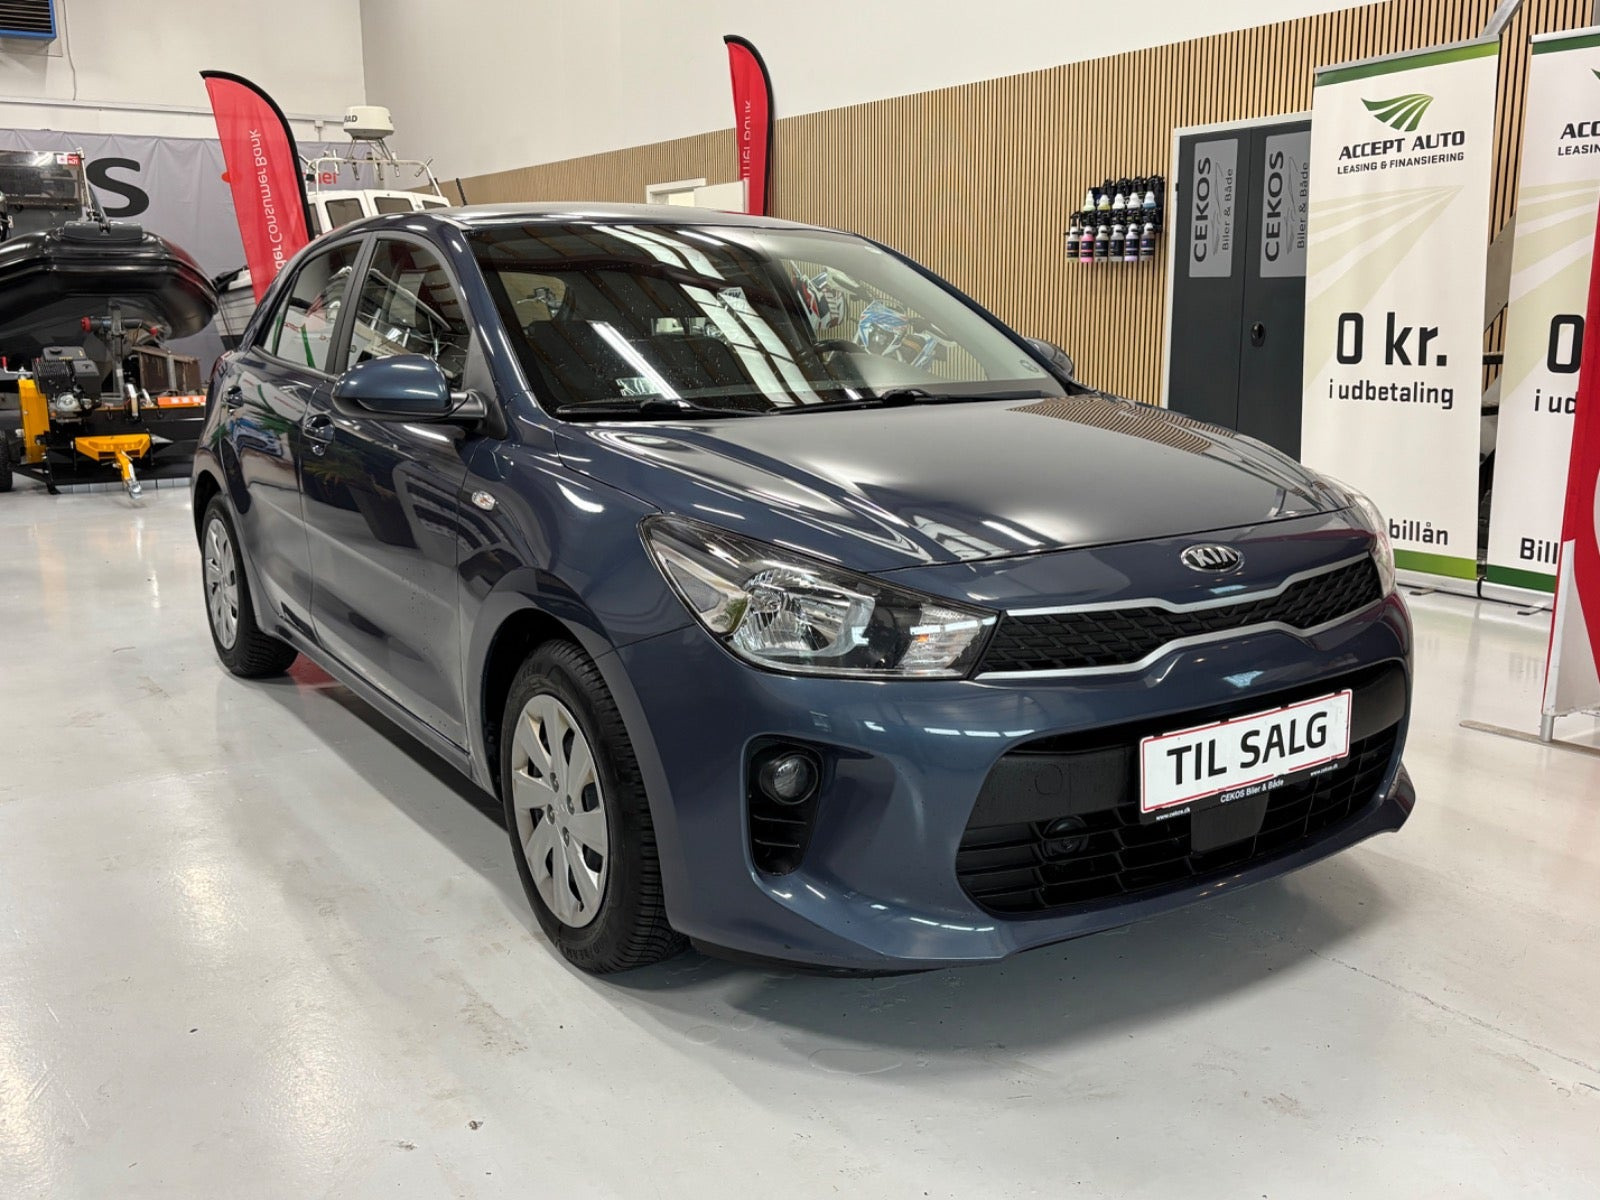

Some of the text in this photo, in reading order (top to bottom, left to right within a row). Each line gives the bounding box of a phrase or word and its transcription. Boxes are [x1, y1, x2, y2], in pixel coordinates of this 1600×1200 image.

[1338, 130, 1466, 161] ACCEPT AUTO
[1337, 152, 1464, 175] LEASING & FINANSIERING
[1193, 157, 1211, 262] CEKOS
[1222, 168, 1233, 250] Biler & Både
[1265, 151, 1284, 262] CEKOS
[1297, 162, 1309, 249] Biler & Både
[1336, 311, 1448, 367] 0 kr.
[1329, 378, 1454, 410] i udbetaling
[1535, 389, 1541, 412] i
[1389, 518, 1449, 546] billån
[1187, 546, 1237, 567] KIA
[1166, 711, 1328, 785] TIL SALG
[1220, 789, 1245, 803] CEKOS
[1246, 786, 1261, 796] Biler
